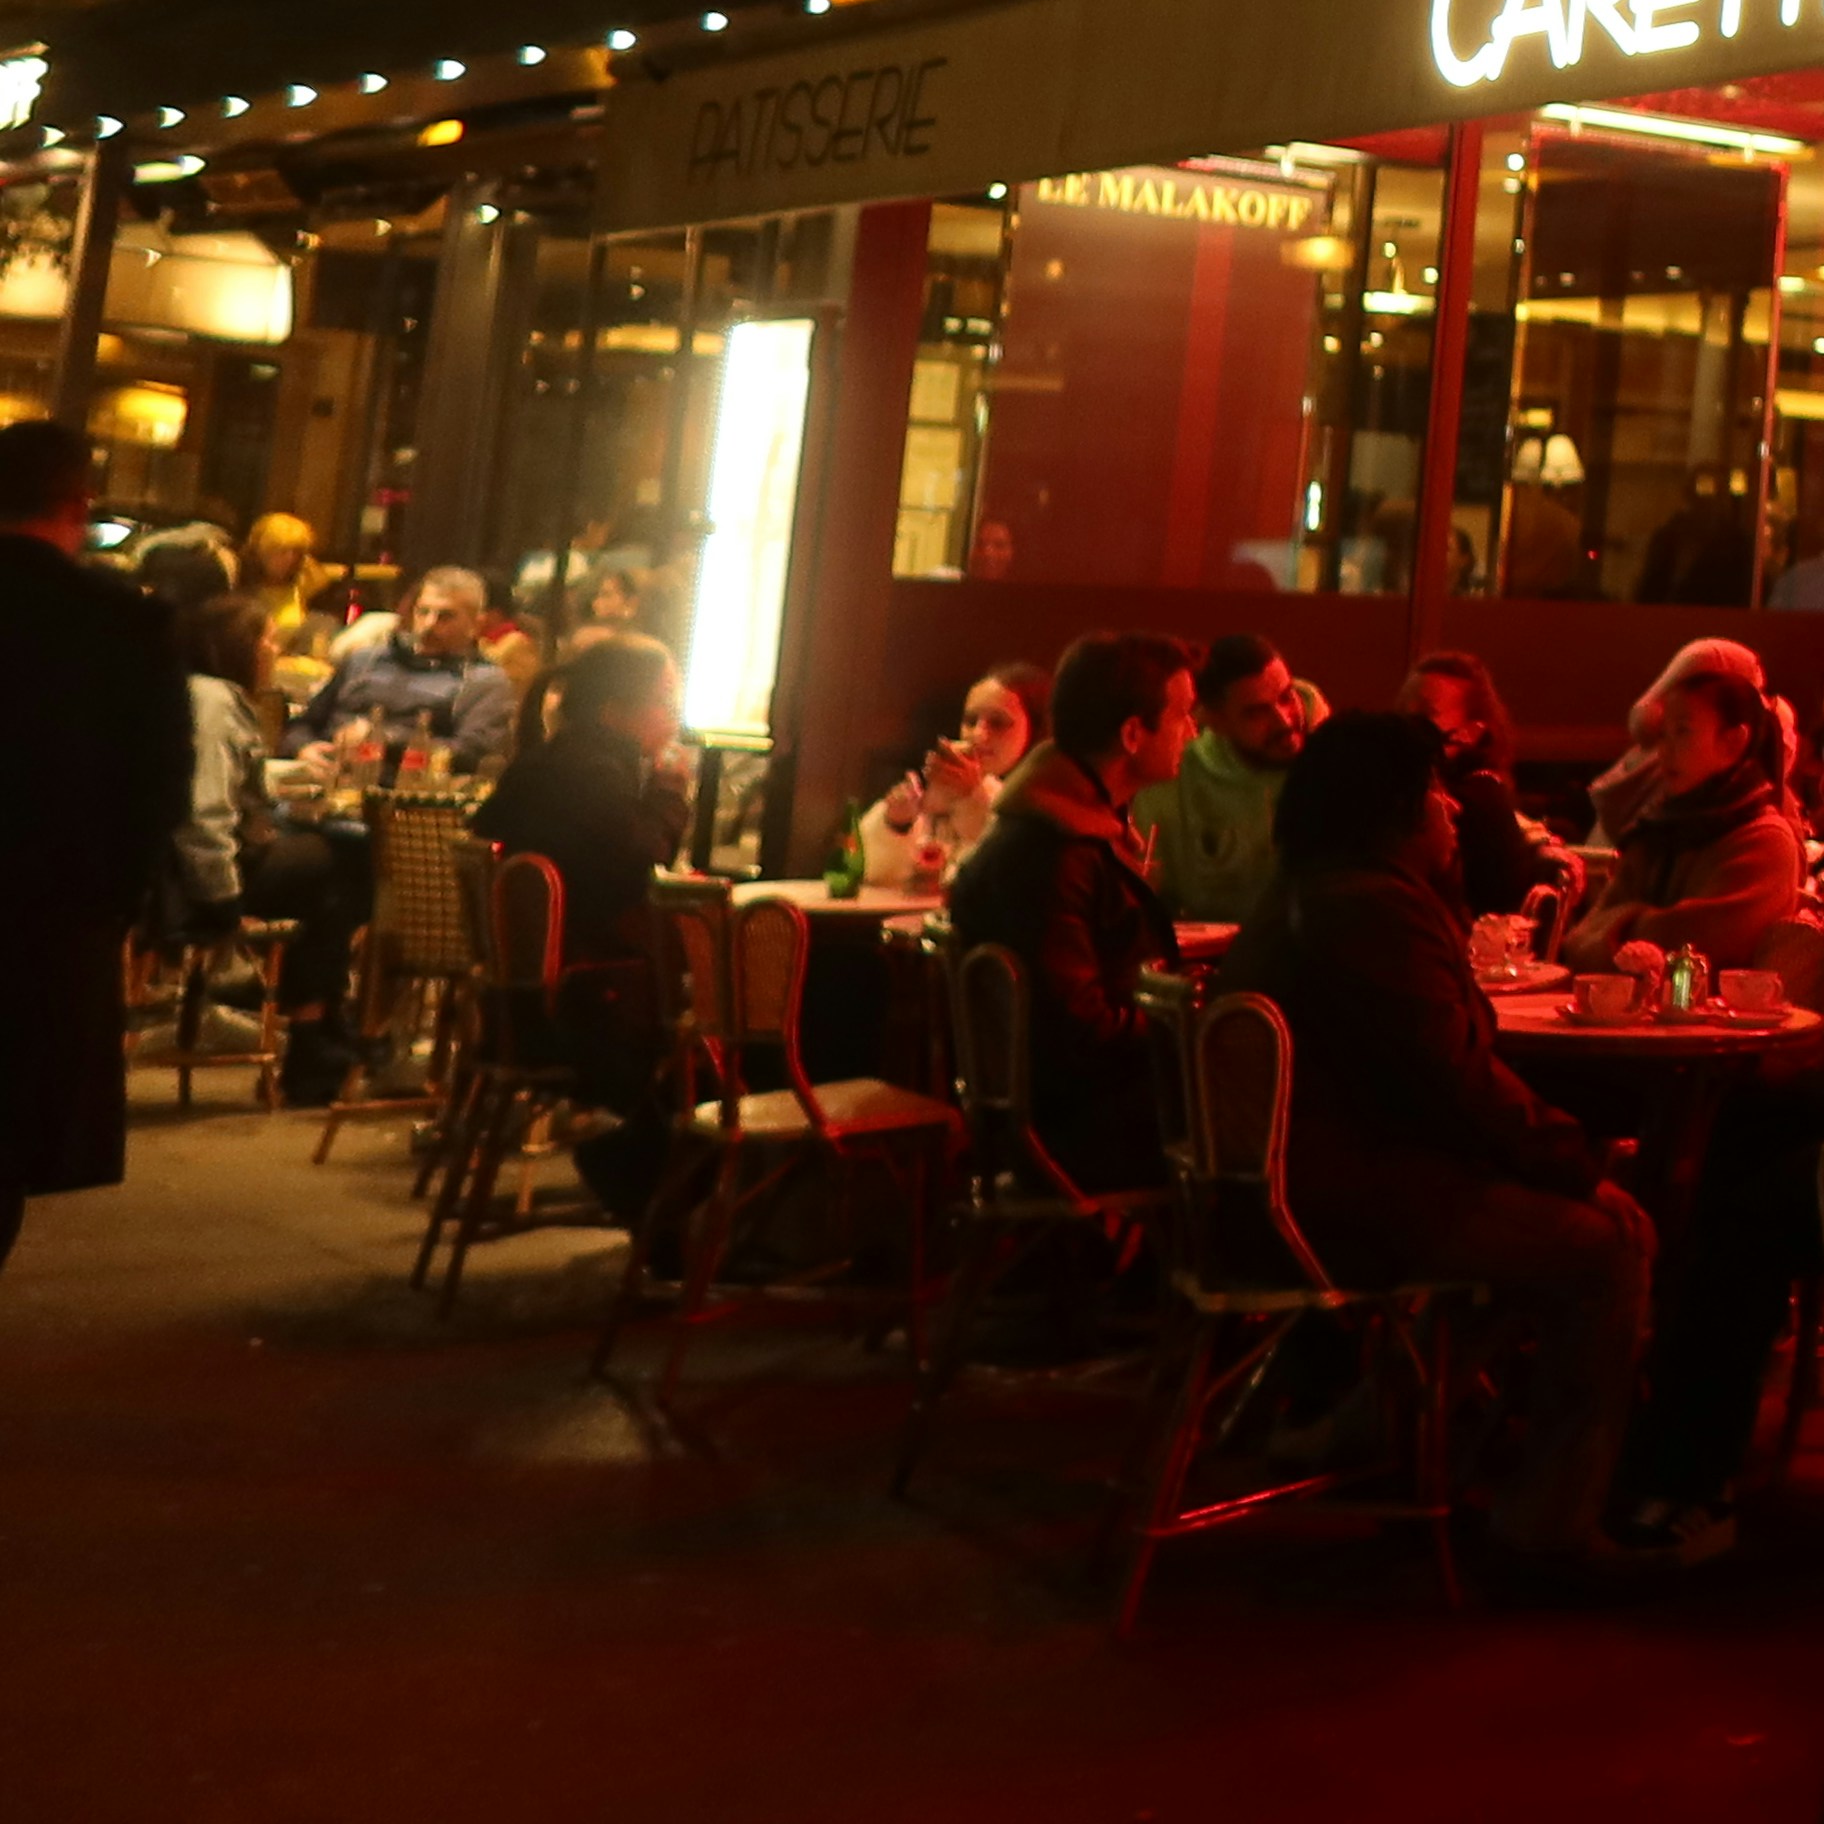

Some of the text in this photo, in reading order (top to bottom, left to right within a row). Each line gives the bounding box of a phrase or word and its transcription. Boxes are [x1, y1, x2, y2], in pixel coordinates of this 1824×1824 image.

[686, 57, 948, 186] PATISSERIE
[1036, 172, 1314, 232] LE MALAKOFF
